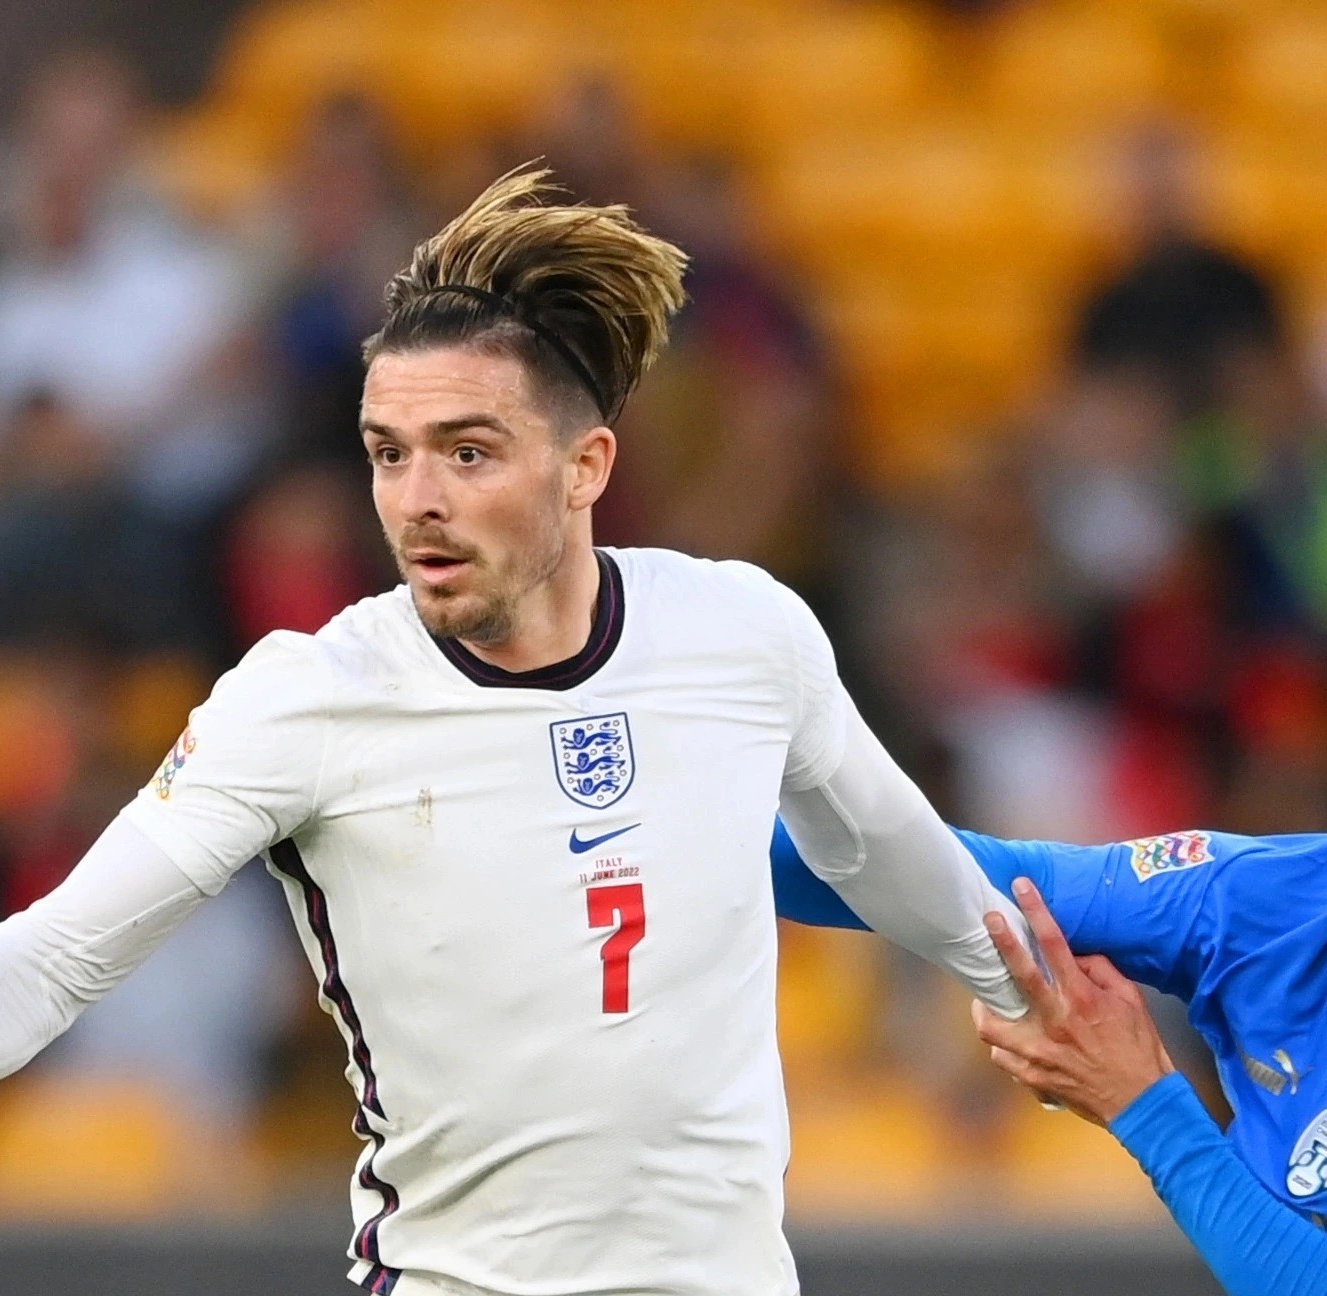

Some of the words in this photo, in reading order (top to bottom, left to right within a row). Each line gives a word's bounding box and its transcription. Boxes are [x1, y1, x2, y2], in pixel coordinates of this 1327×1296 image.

[595, 857, 623, 869] ITALY
[579, 873, 588, 884] 11
[591, 869, 615, 882] JUNE
[618, 866, 640, 878] 2022
[586, 883, 646, 1014] 7
